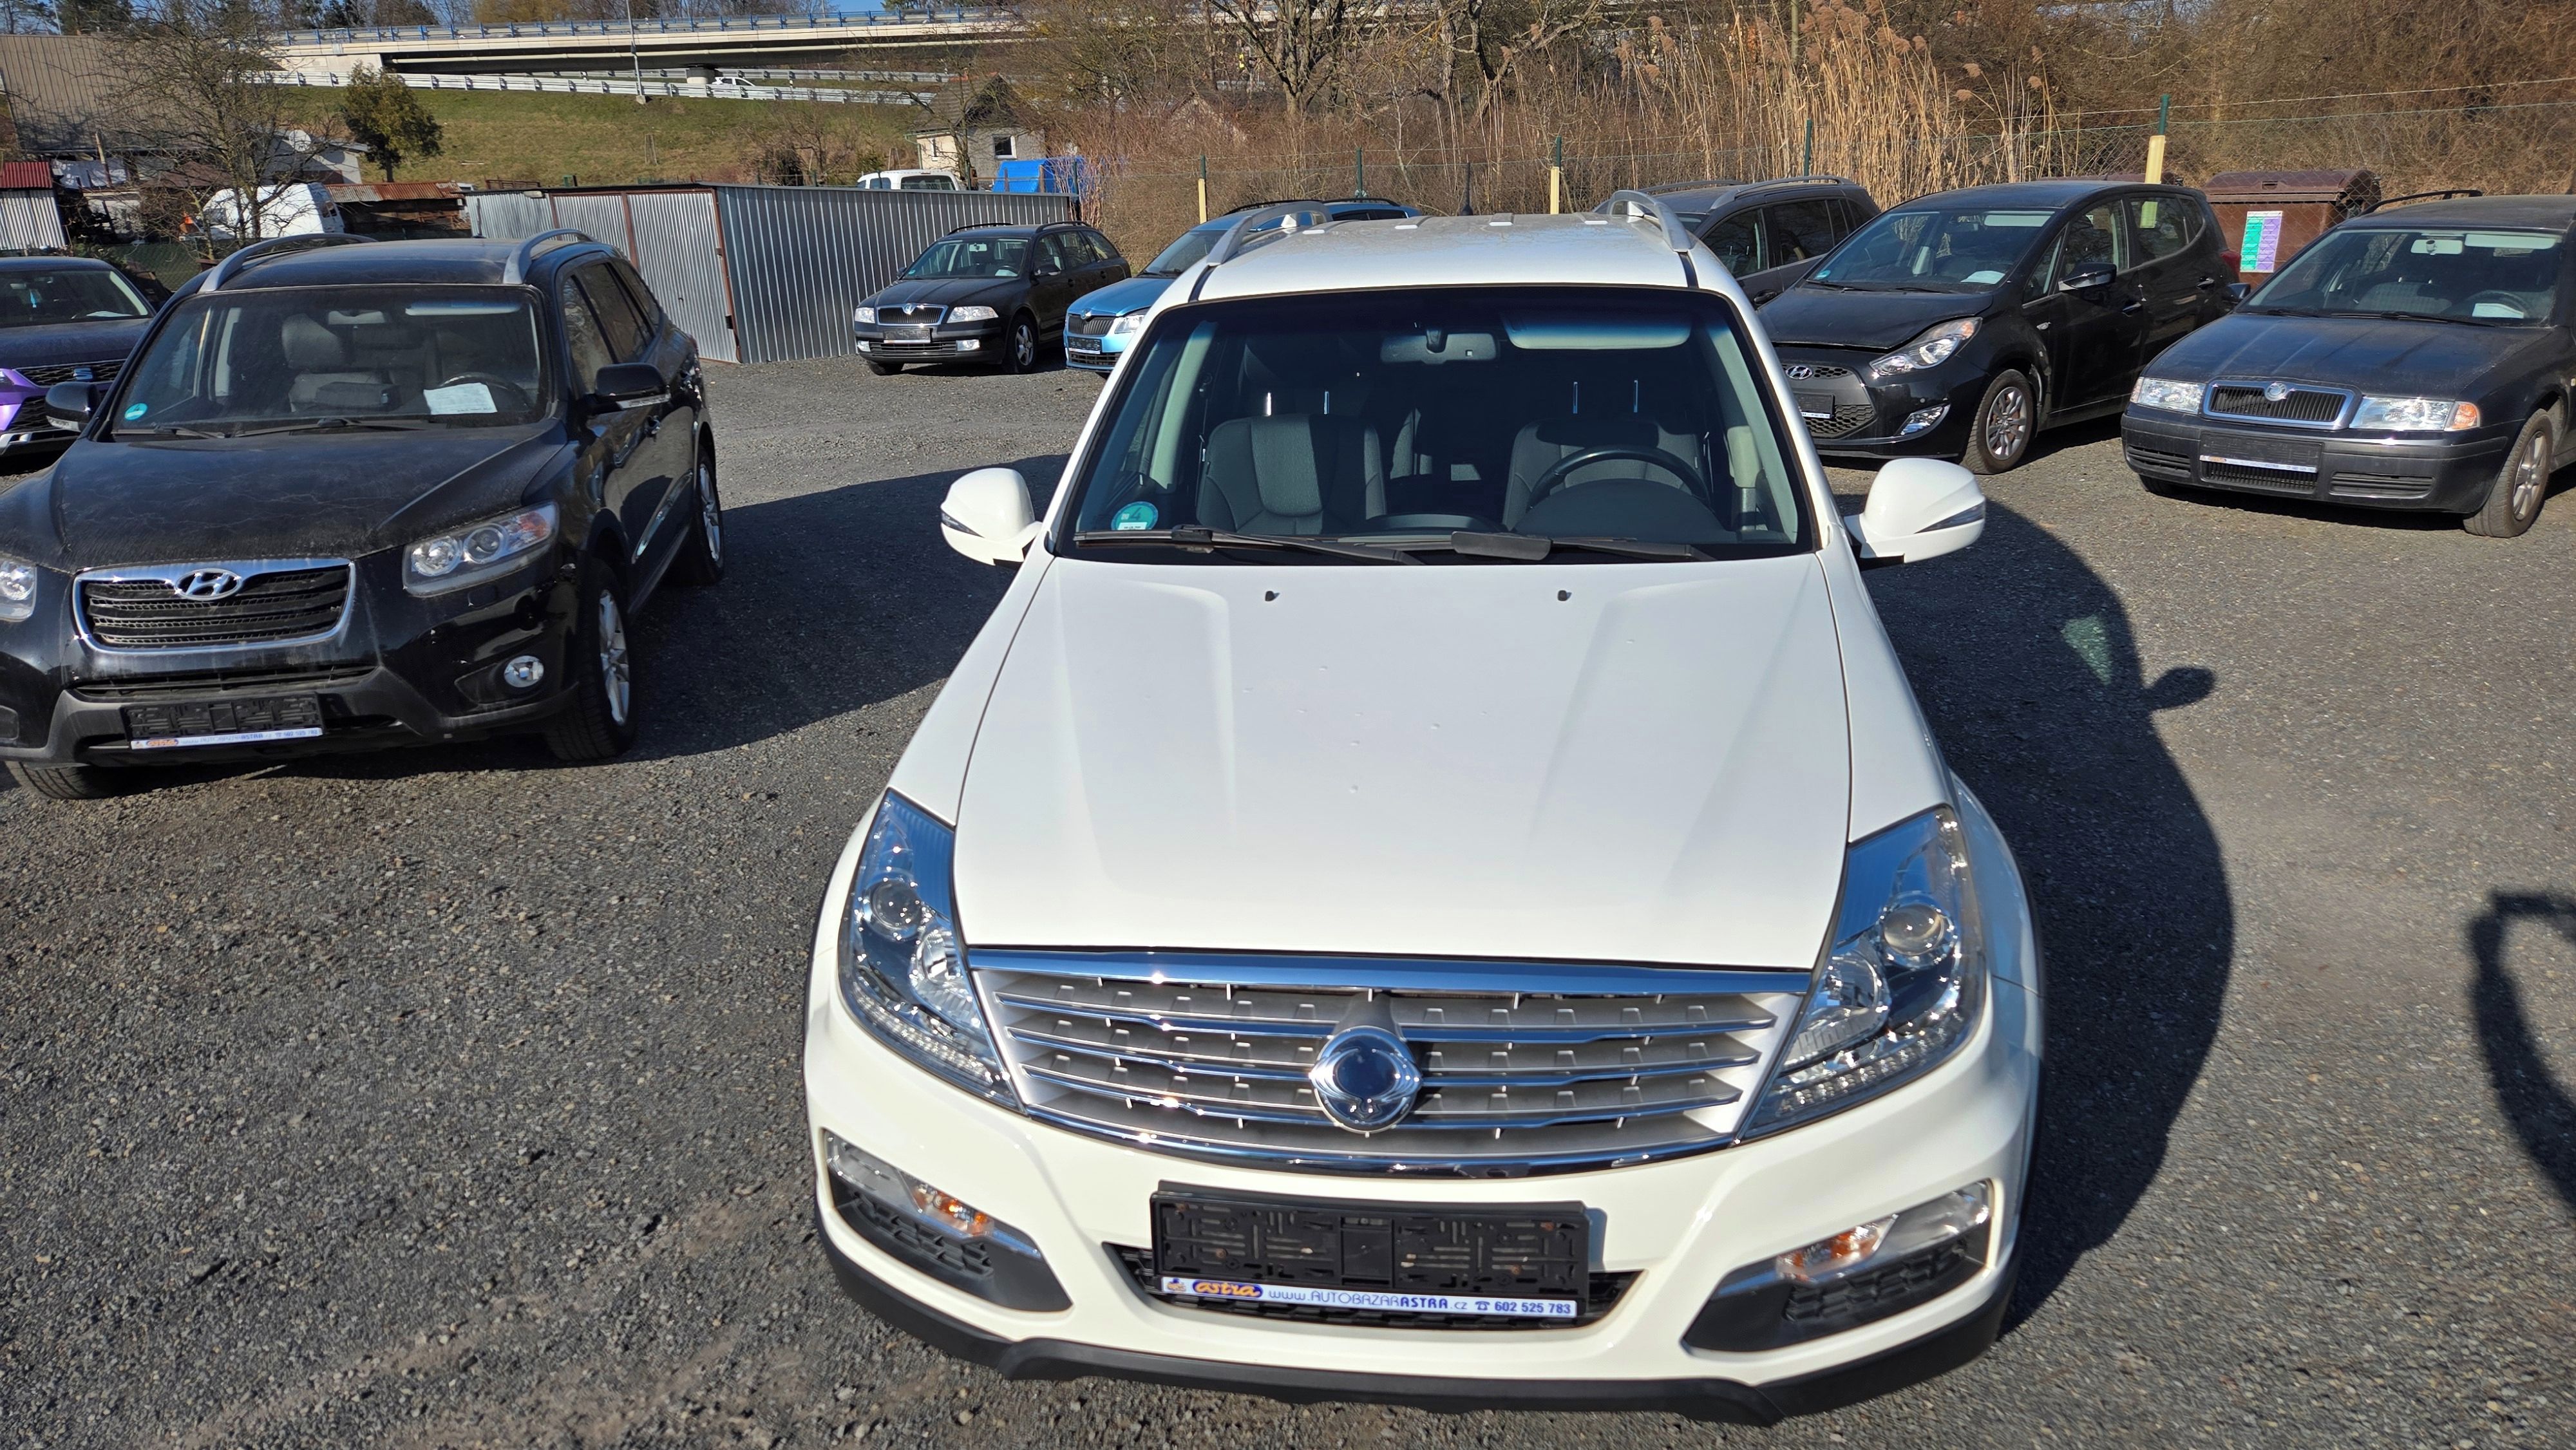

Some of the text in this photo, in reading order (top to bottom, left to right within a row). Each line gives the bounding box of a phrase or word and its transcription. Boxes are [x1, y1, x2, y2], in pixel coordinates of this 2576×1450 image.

[1130, 507, 1141, 520] 4
[1195, 1281, 1260, 1297] astra
[1495, 1301, 1517, 1312] 602
[1522, 1302, 1544, 1313] 525
[1549, 1303, 1571, 1314] 783
